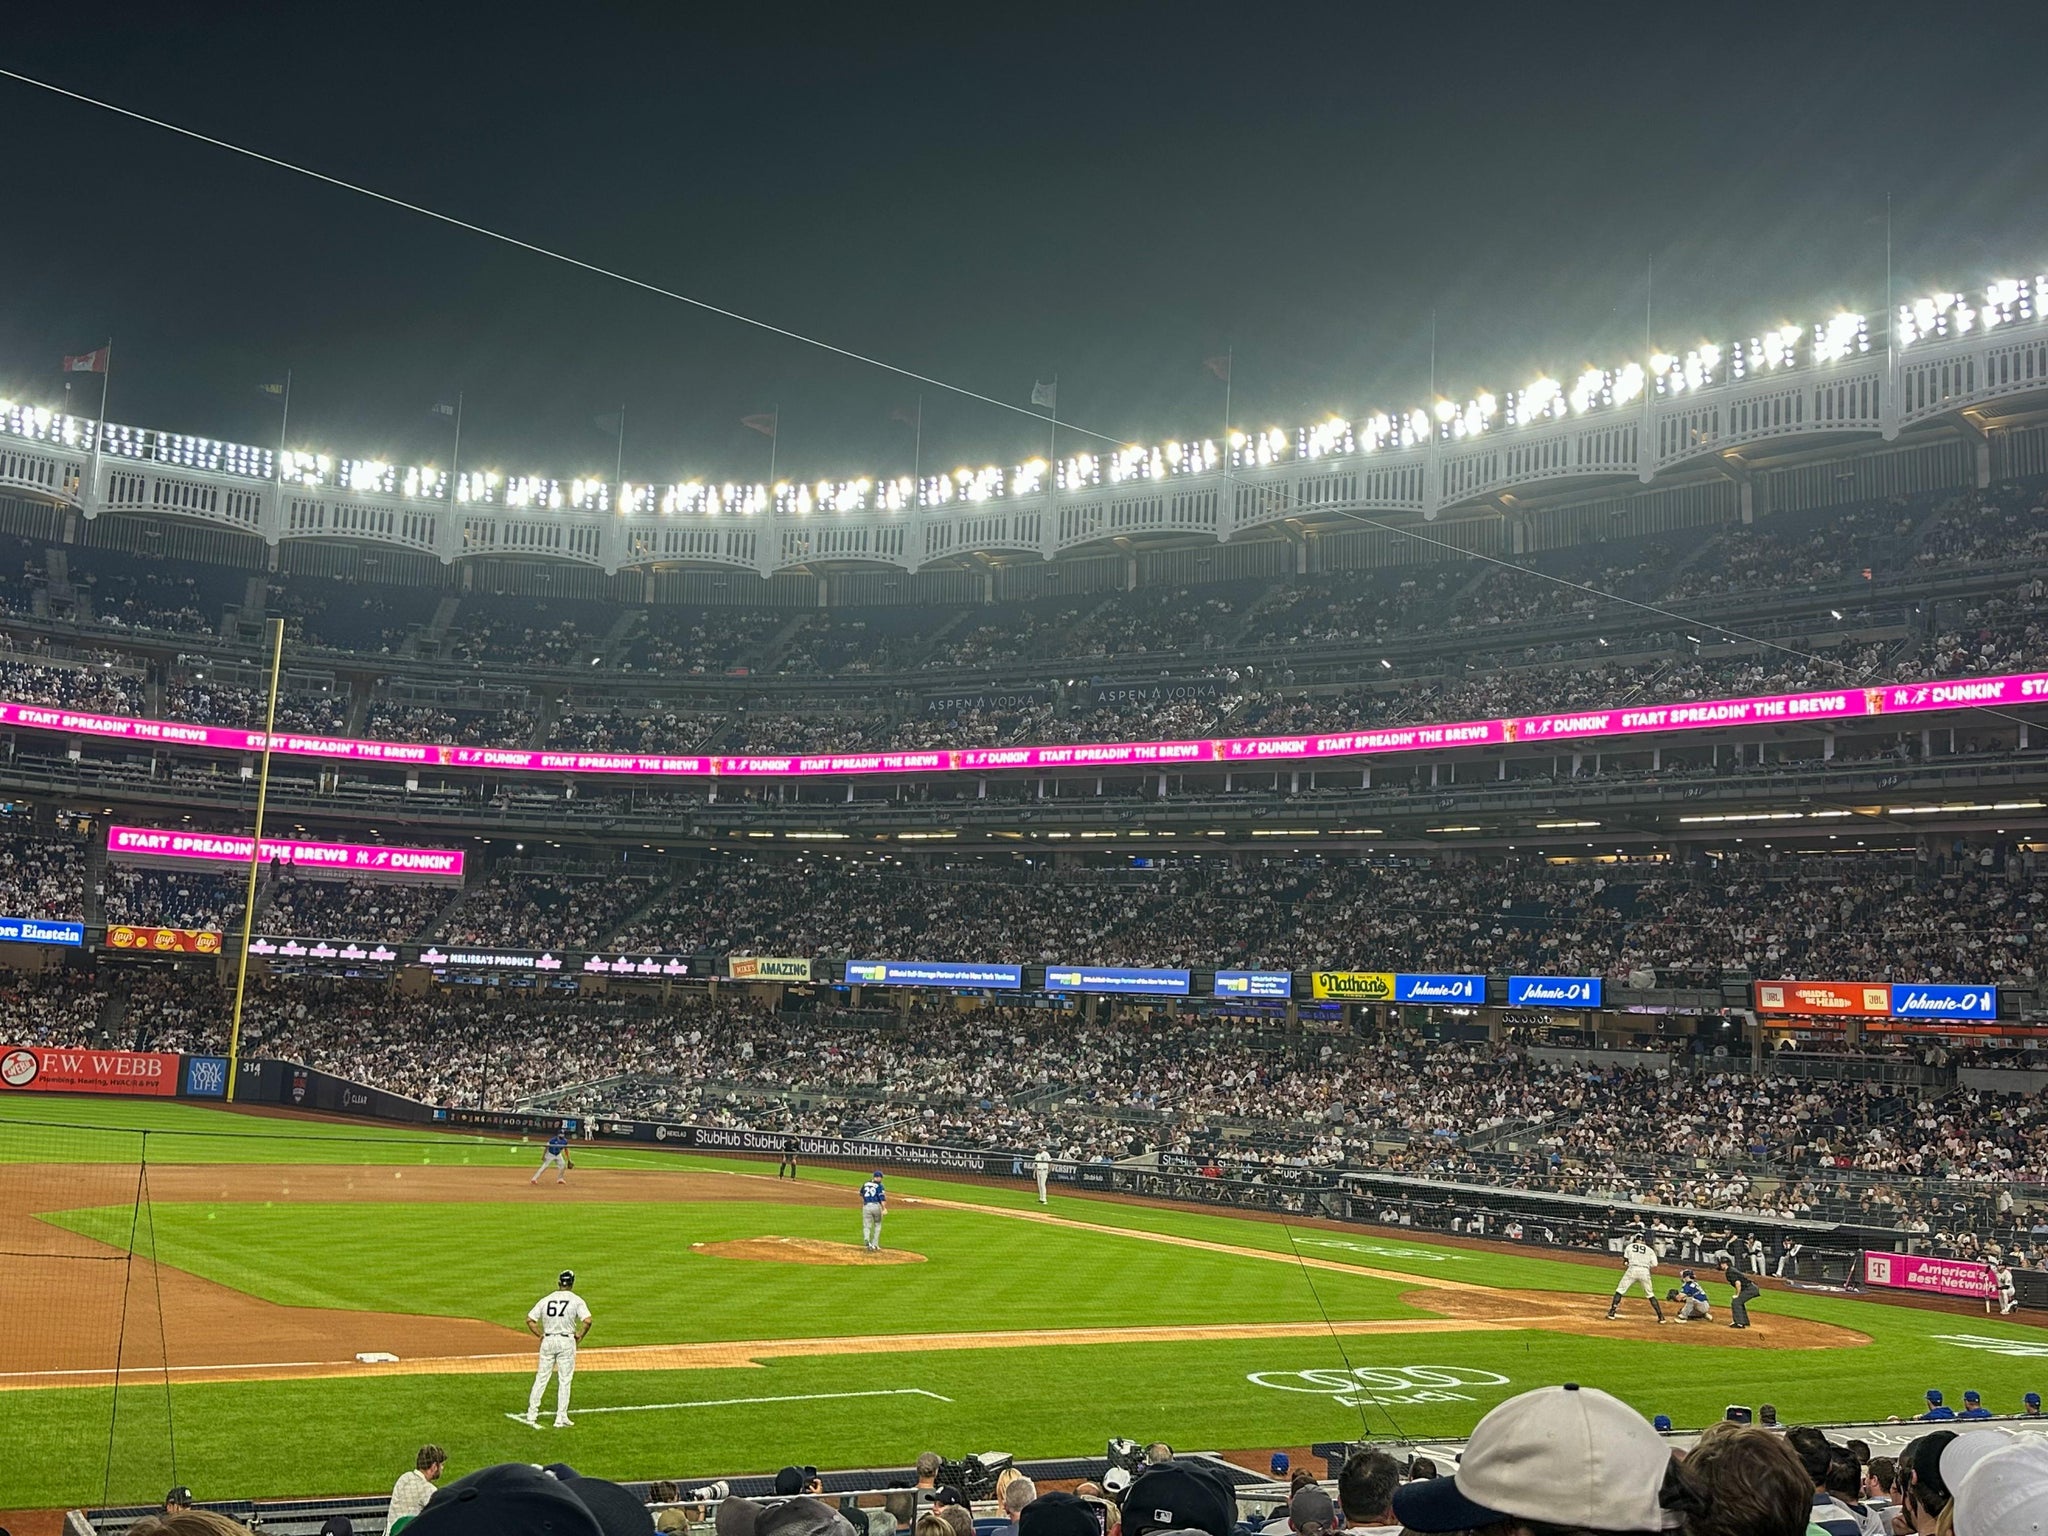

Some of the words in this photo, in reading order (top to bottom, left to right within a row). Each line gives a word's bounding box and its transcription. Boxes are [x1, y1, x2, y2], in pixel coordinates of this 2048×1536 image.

[1098, 689, 1146, 702] ASPEN
[1166, 685, 1216, 698] VODKA
[1932, 682, 2005, 702] DUNKIN'
[928, 699, 972, 711] ASPEN
[990, 695, 1035, 707] VODKA
[1621, 712, 1666, 728] START
[1669, 705, 1750, 724] SPREADIN'
[1753, 701, 1786, 717] THE
[1788, 696, 1846, 714] BREWS
[18, 709, 60, 725] START
[61, 715, 131, 732] SPREADIN'
[133, 723, 159, 736] THE
[162, 727, 207, 741] BREWS
[1553, 715, 1610, 733] DUNKIN'
[1317, 738, 1354, 751] START
[1354, 733, 1415, 749] SPREADIN'
[1418, 730, 1443, 743] THE
[1445, 726, 1488, 741] BREWS
[288, 739, 354, 754] SPREADIN'
[357, 744, 382, 756] THE
[383, 747, 425, 759] BREWS
[1039, 750, 1072, 762] START
[1074, 747, 1132, 761] SPREADIN'
[1134, 746, 1157, 758] THE
[1159, 745, 1199, 757] BREWS
[1258, 740, 1307, 754] DUNKIN'
[483, 753, 531, 766] DUNKIN'
[541, 755, 575, 767] START
[578, 757, 636, 769] SPREADIN'
[638, 759, 661, 769] THE
[662, 760, 699, 771] BREWS
[750, 760, 791, 771] DUNKIN'
[800, 759, 831, 770] START
[831, 757, 882, 770] SPREADIN'
[884, 756, 902, 767] THE
[904, 755, 938, 767] BREWS
[988, 751, 1031, 764] DUNKIN'
[117, 833, 171, 849] START
[172, 836, 257, 856] SPREADIN'
[260, 845, 291, 859] THE
[294, 848, 348, 863] BREWS
[391, 853, 455, 868] DUNKIN'
[21, 924, 80, 942] Einstein
[450, 953, 494, 965] MELISSA'S
[495, 956, 534, 967] PRODUCE
[760, 963, 807, 976] AMAZING
[1319, 973, 1388, 993] Nathan's
[1868, 994, 1884, 1005] JBL
[1897, 992, 1976, 1013] Johnnie-O
[41, 1053, 83, 1074] F.W.
[92, 1056, 162, 1077] WEBB
[195, 1062, 221, 1072] NEW
[243, 1062, 261, 1073] 314
[191, 1070, 223, 1082] YORK
[193, 1080, 218, 1091] LIFE
[351, 1094, 368, 1105] CLEAR
[696, 1129, 741, 1146] StubHub
[800, 1140, 840, 1155] tubHub
[842, 1141, 892, 1160] StubHub
[895, 1146, 939, 1165] StubHub
[941, 1151, 985, 1169] StubHub
[864, 1186, 877, 1198] 29
[1632, 1244, 1646, 1254] 99
[1907, 1271, 1937, 1285] Best
[1918, 1262, 1989, 1280] America's
[546, 1300, 570, 1317] 67
